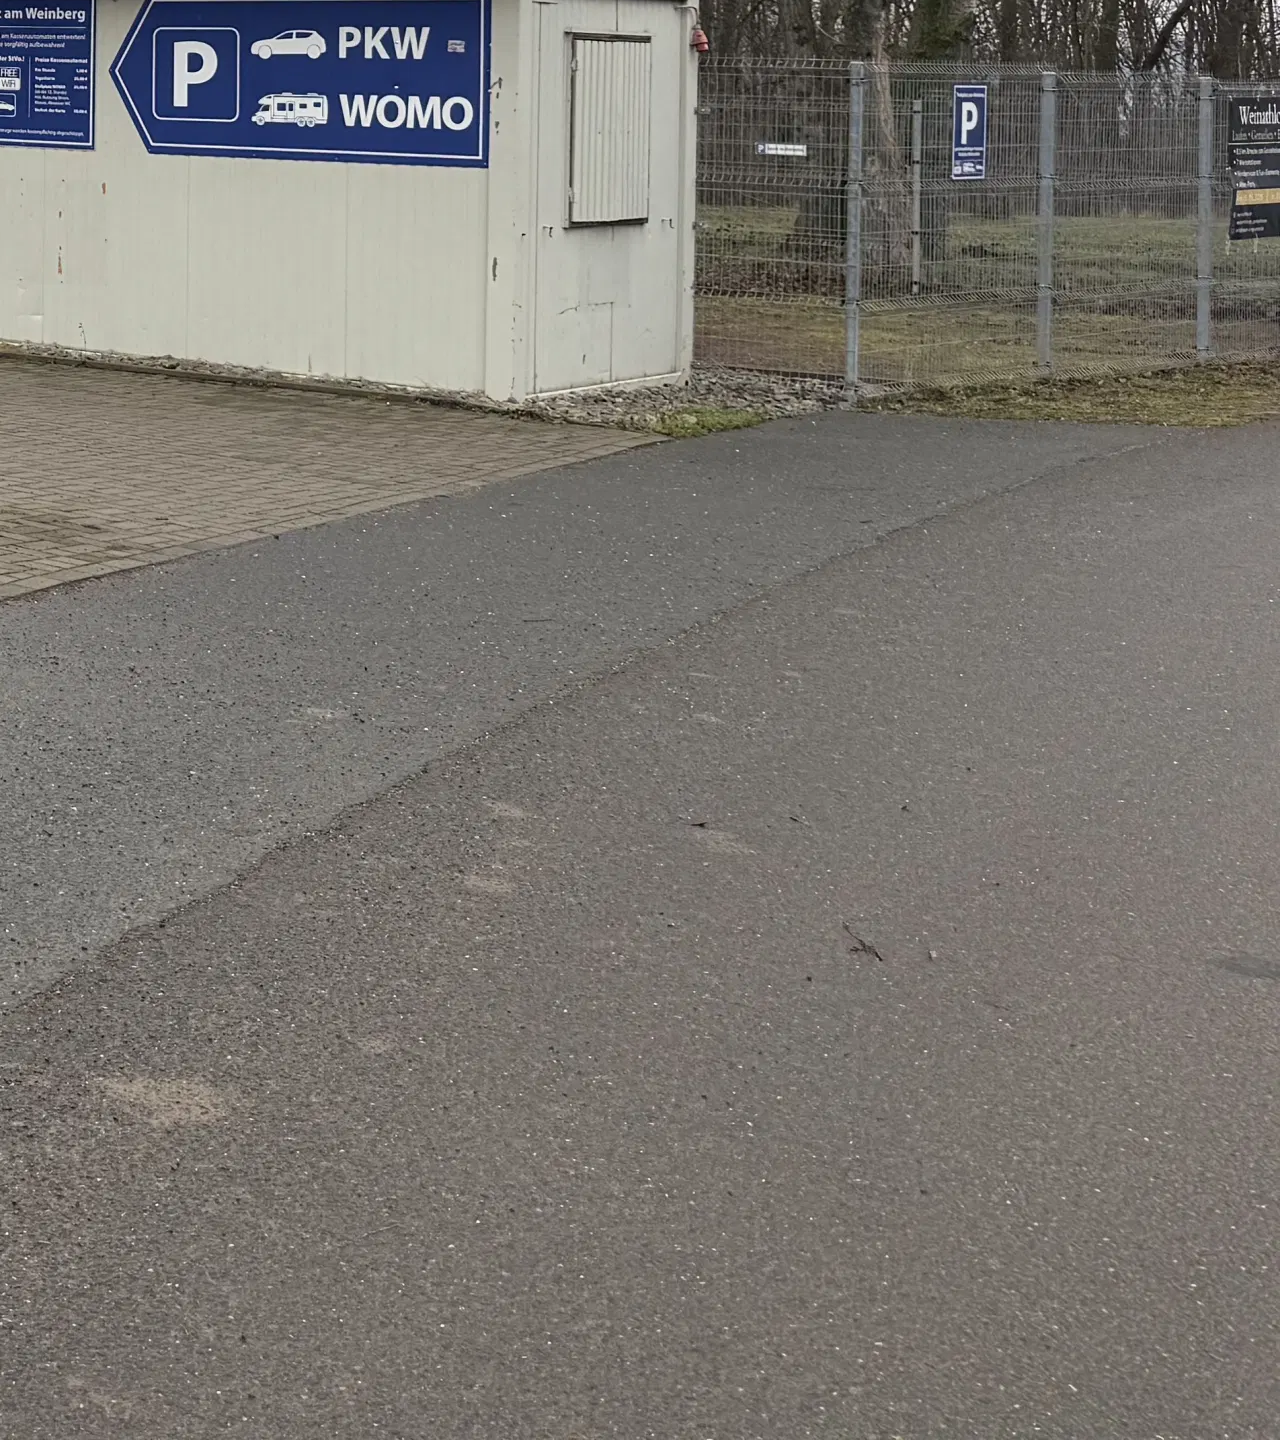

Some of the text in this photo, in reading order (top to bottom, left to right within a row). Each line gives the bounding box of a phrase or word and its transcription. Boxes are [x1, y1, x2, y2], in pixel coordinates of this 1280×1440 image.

[4, 10, 23, 19] am
[25, 7, 86, 23] Weinberg
[338, 26, 431, 60] PKW
[0, 68, 18, 77] FREE
[173, 40, 218, 107] P
[339, 93, 474, 131] WOMO
[960, 101, 979, 145] P
